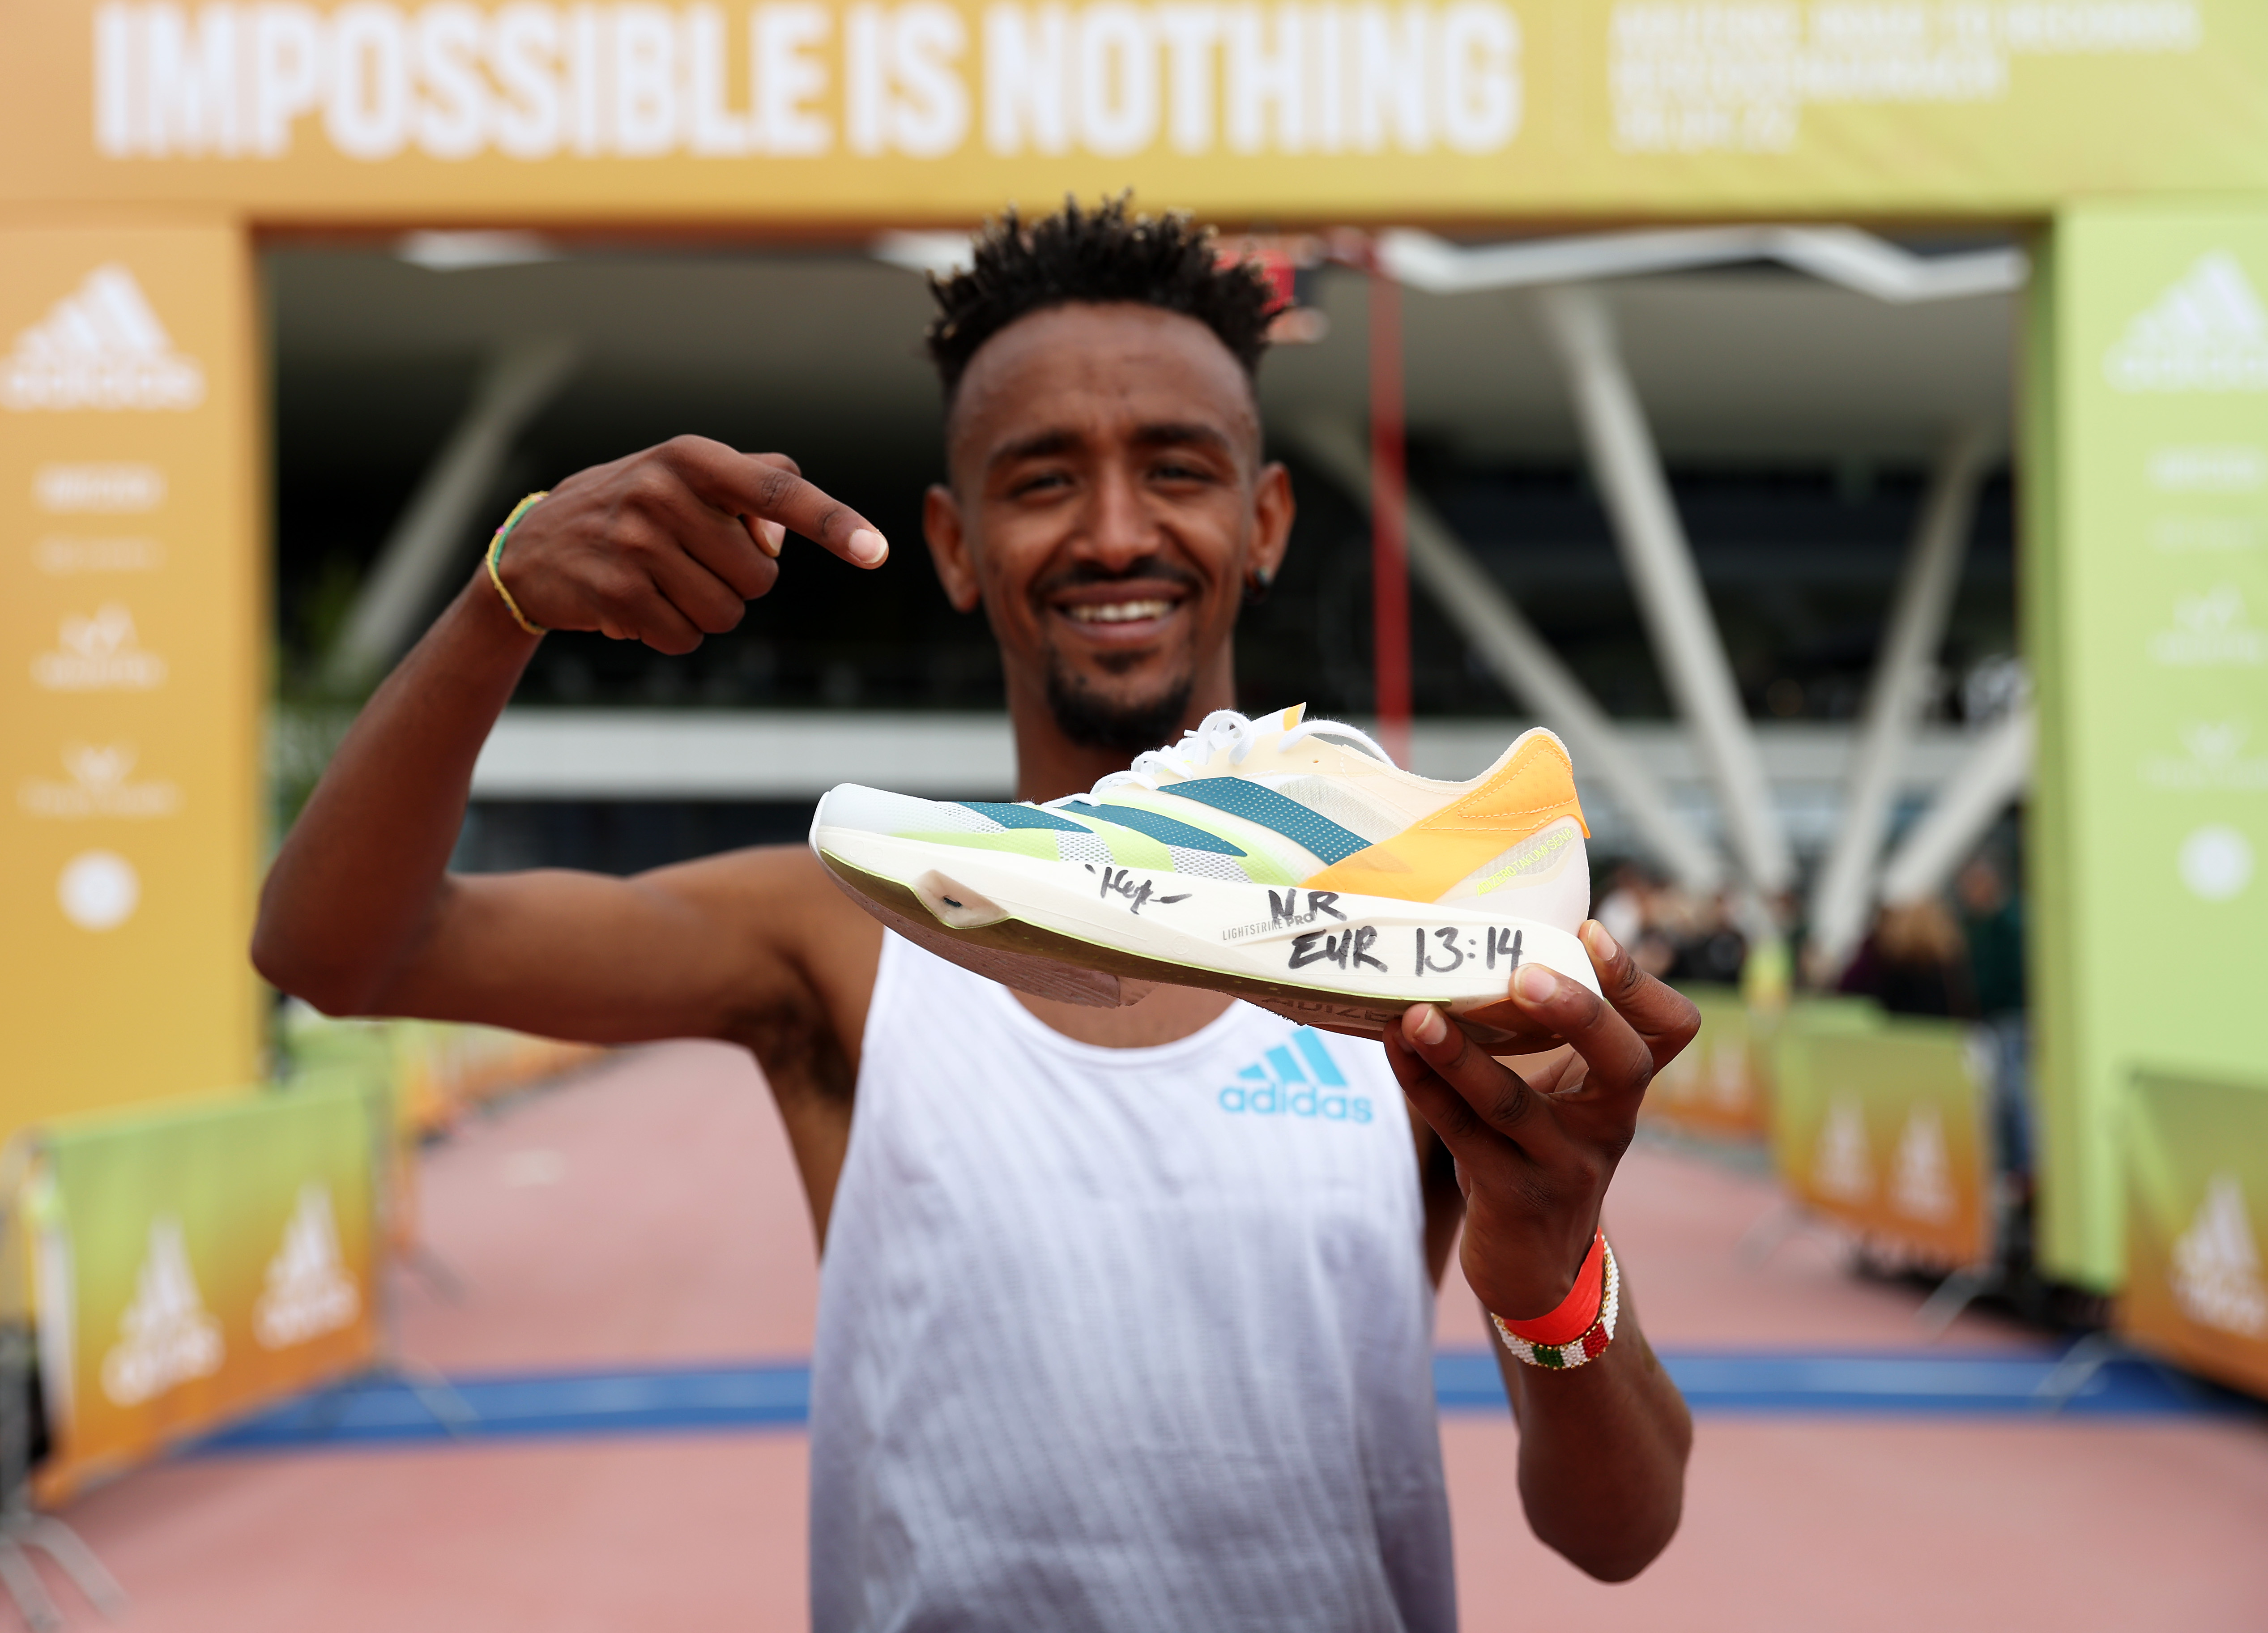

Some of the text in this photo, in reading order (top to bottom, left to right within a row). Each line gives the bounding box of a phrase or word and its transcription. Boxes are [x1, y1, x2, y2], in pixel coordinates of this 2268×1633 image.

[95, 2, 1522, 157] IMPOSSIBLE IS NOTHING
[1477, 866, 1516, 896] ADIZERO
[1512, 844, 1550, 870] TAKUMI
[1223, 912, 1314, 941] LIGHTSTRIKE PRO
[1288, 925, 1523, 976] EUR 13:14
[1218, 1082, 1373, 1124] adidas
